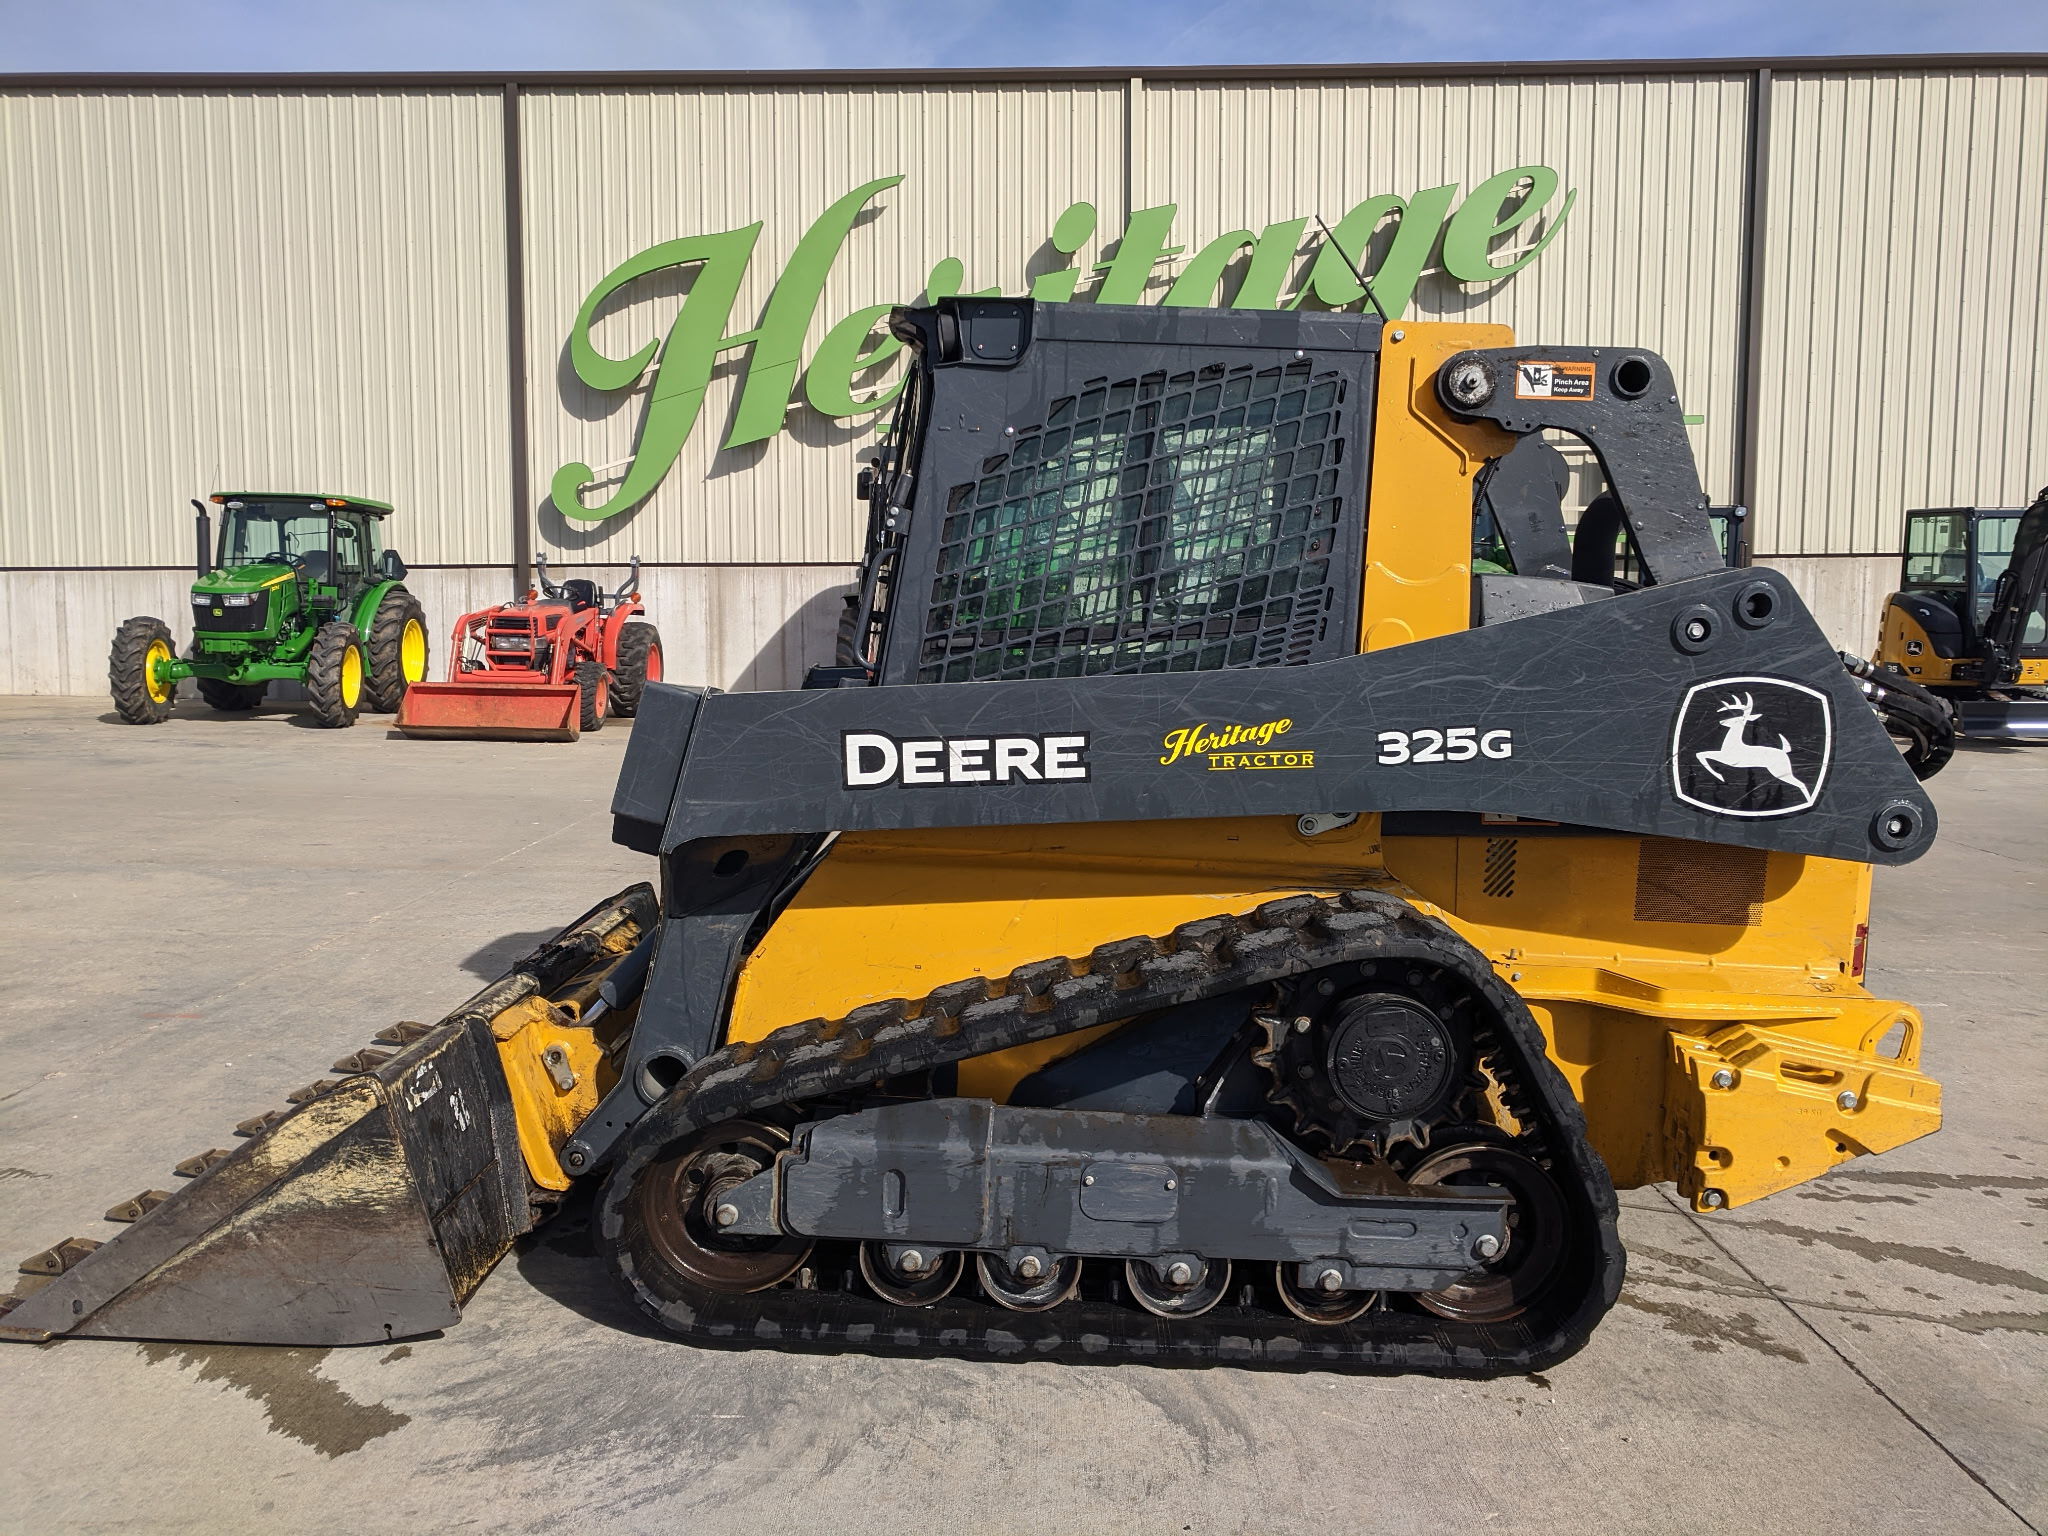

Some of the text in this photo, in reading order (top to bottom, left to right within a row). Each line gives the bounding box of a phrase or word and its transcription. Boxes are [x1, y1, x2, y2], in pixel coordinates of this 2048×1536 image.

[1553, 386, 1584, 394] Keep Away
[845, 734, 1086, 785] DEERE
[1160, 718, 1293, 765] Heritage
[1377, 727, 1512, 765] 325G
[1208, 754, 1315, 768] TRACTOR
